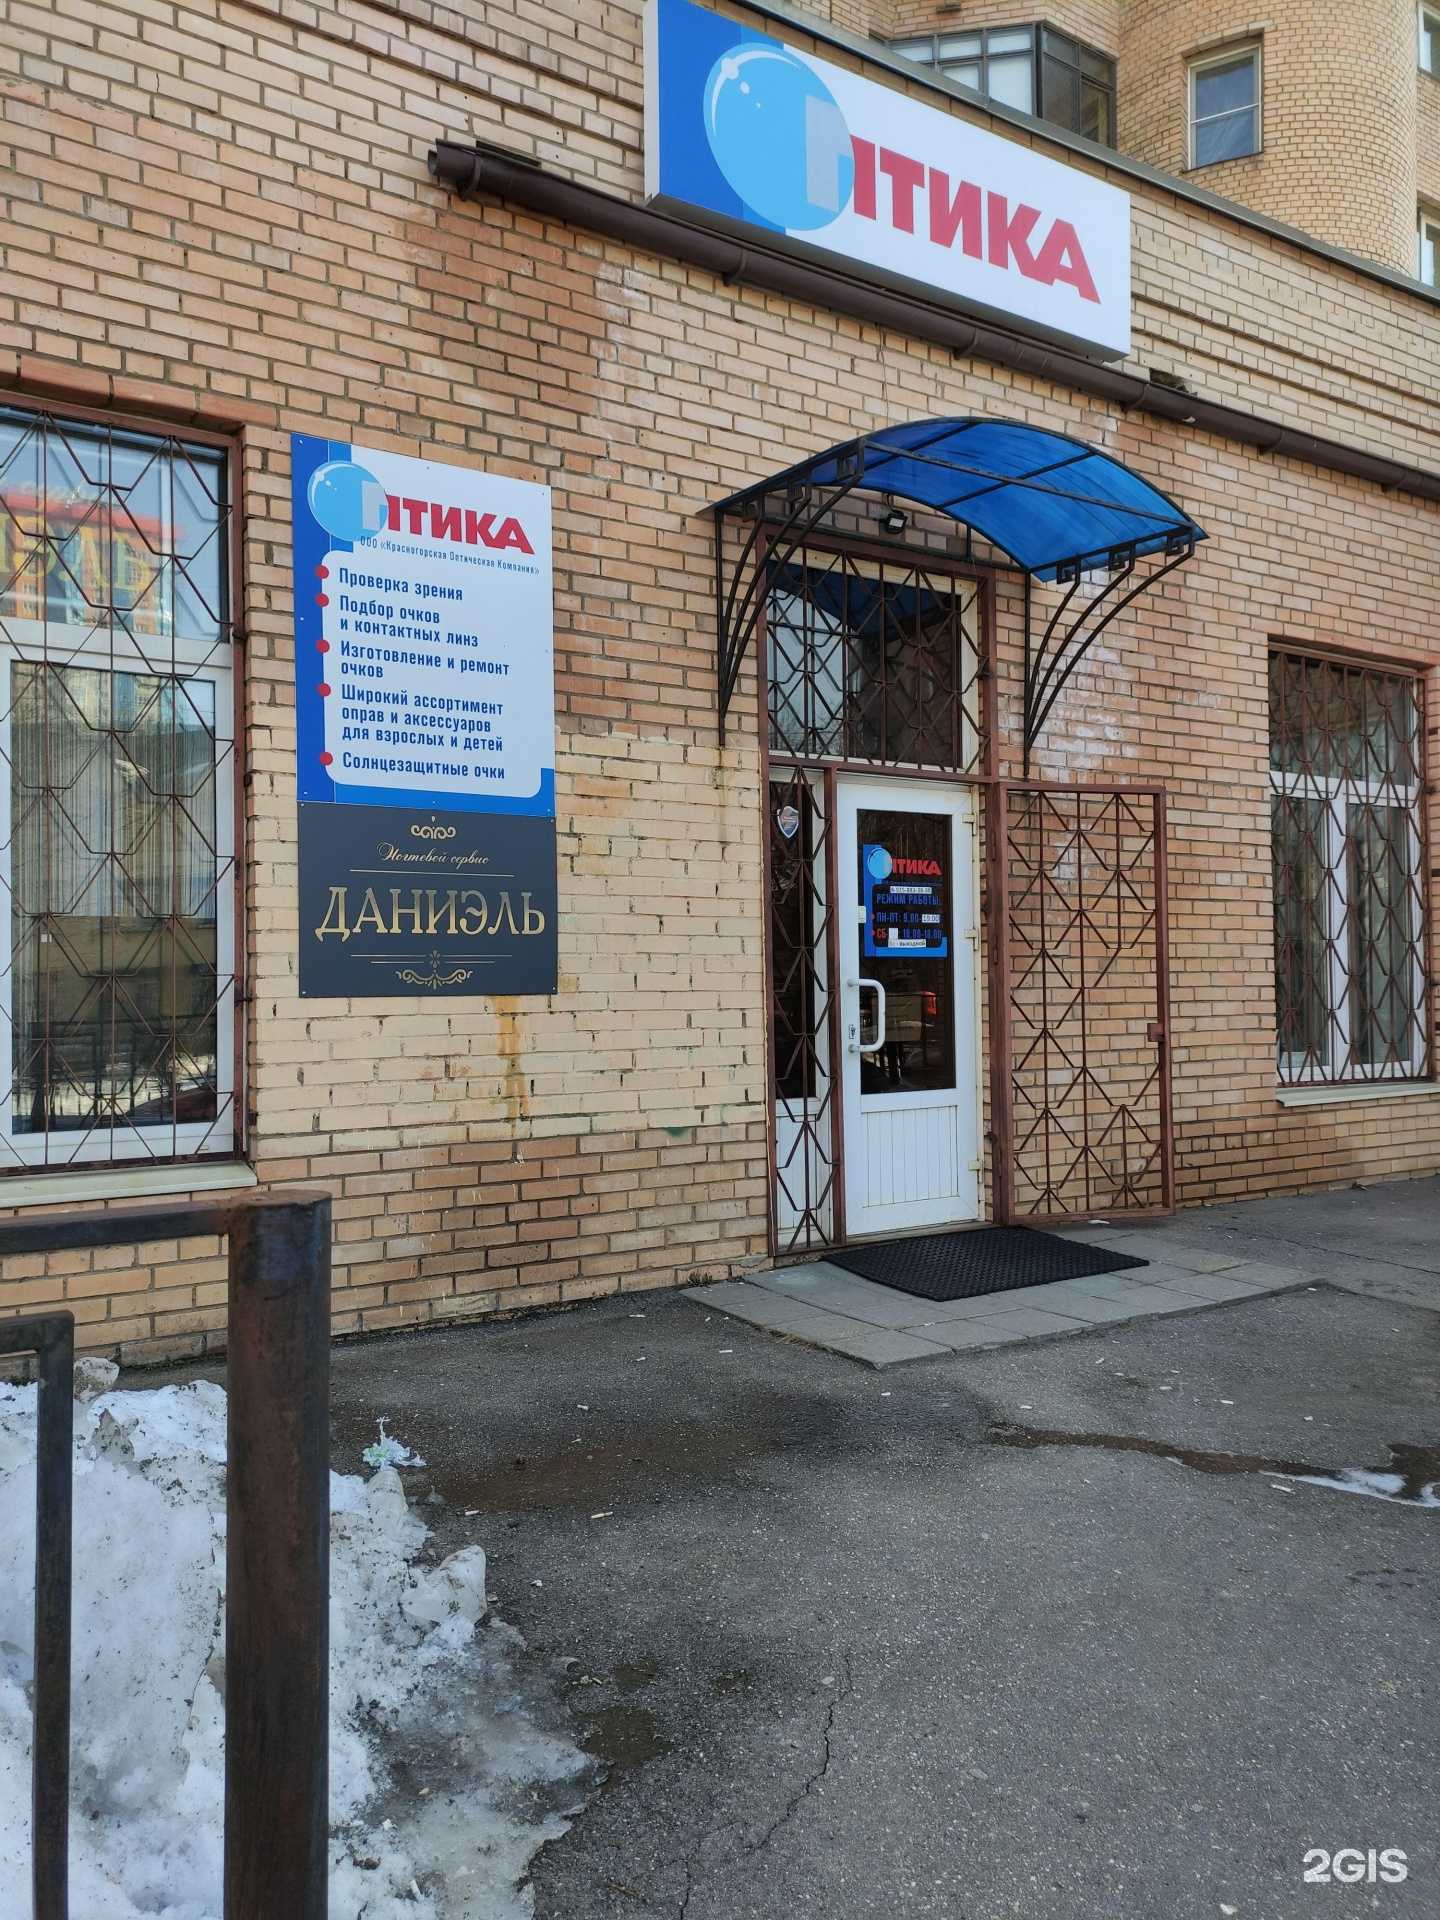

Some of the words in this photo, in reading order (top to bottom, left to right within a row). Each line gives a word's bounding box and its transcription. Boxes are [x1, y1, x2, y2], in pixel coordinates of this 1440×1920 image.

[360, 536, 378, 549] ООО
[449, 551, 495, 569] Оптическая
[339, 567, 409, 593] Проверка
[414, 582, 463, 601] зрения
[339, 595, 394, 620] Подбор
[399, 607, 440, 624] очков
[340, 618, 348, 631] и
[355, 620, 441, 643] контактных
[446, 631, 479, 647] линз
[340, 640, 441, 668] Изготовление
[447, 656, 455, 669] и
[460, 658, 509, 676] ремонт
[341, 662, 384, 679] очков
[341, 683, 408, 706] Широкий
[414, 695, 504, 715] ассортимент
[342, 706, 385, 724] оправ
[390, 711, 399, 724] и
[404, 713, 491, 734] аксессуаров
[342, 726, 370, 741] для
[376, 728, 445, 746] взрослых
[450, 736, 459, 748] и
[463, 737, 504, 752] детей
[342, 751, 469, 777] Солнцезащитные
[474, 765, 505, 780] очки
[376, 841, 448, 862] Ногтевой
[450, 849, 489, 870] сервис
[876, 893, 906, 905] РЕЖИМ
[314, 886, 545, 942] ДАНИЭЛЬ
